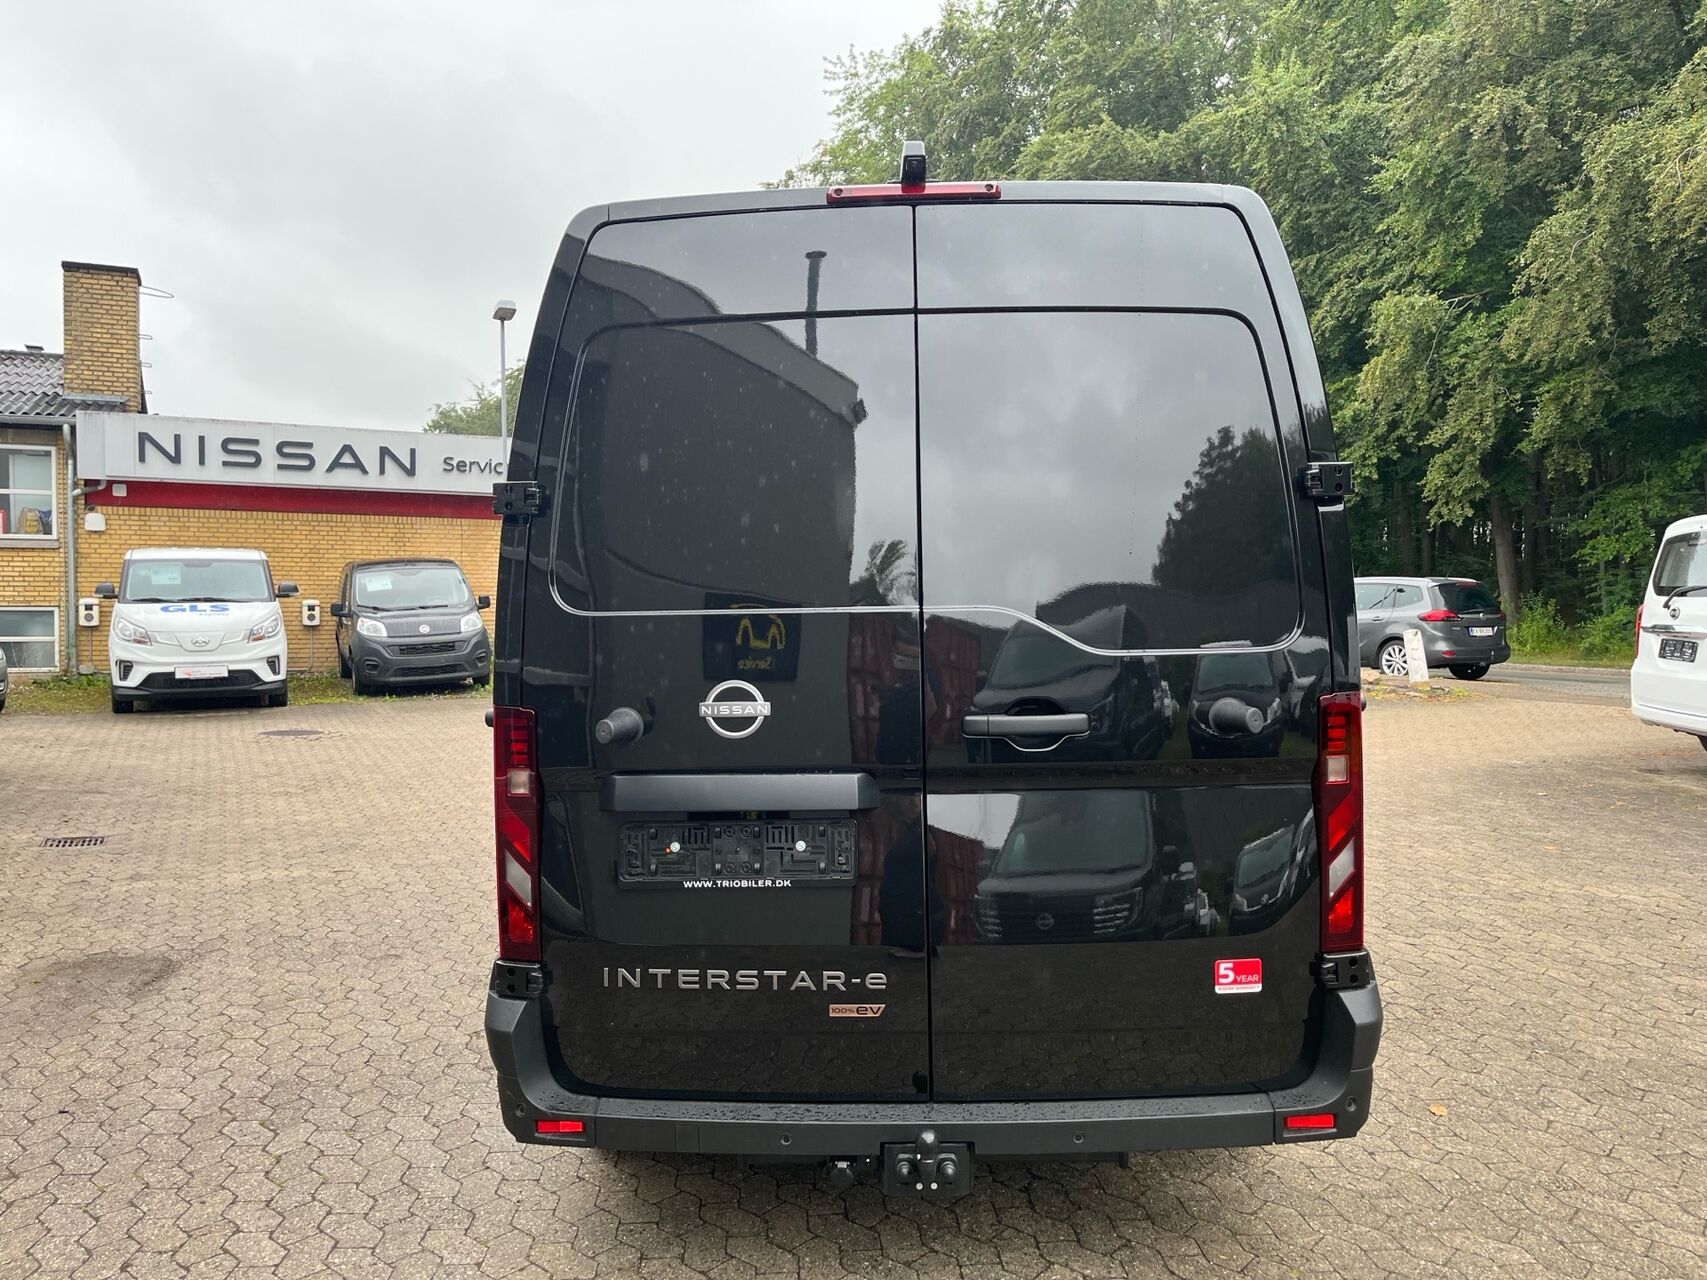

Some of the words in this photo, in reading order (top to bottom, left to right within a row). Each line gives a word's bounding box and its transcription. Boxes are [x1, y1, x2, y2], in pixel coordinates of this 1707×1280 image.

[138, 431, 416, 477] NISSAN
[443, 456, 504, 475] Servic
[160, 604, 230, 613] GLS
[701, 705, 768, 715] NISSAN
[683, 879, 792, 888] WWW.TRIOBILER.DK
[1218, 962, 1235, 984] 5
[1236, 974, 1259, 983] YEAR
[603, 967, 888, 991] INTERSTAR-e
[831, 1007, 855, 1015] 100%
